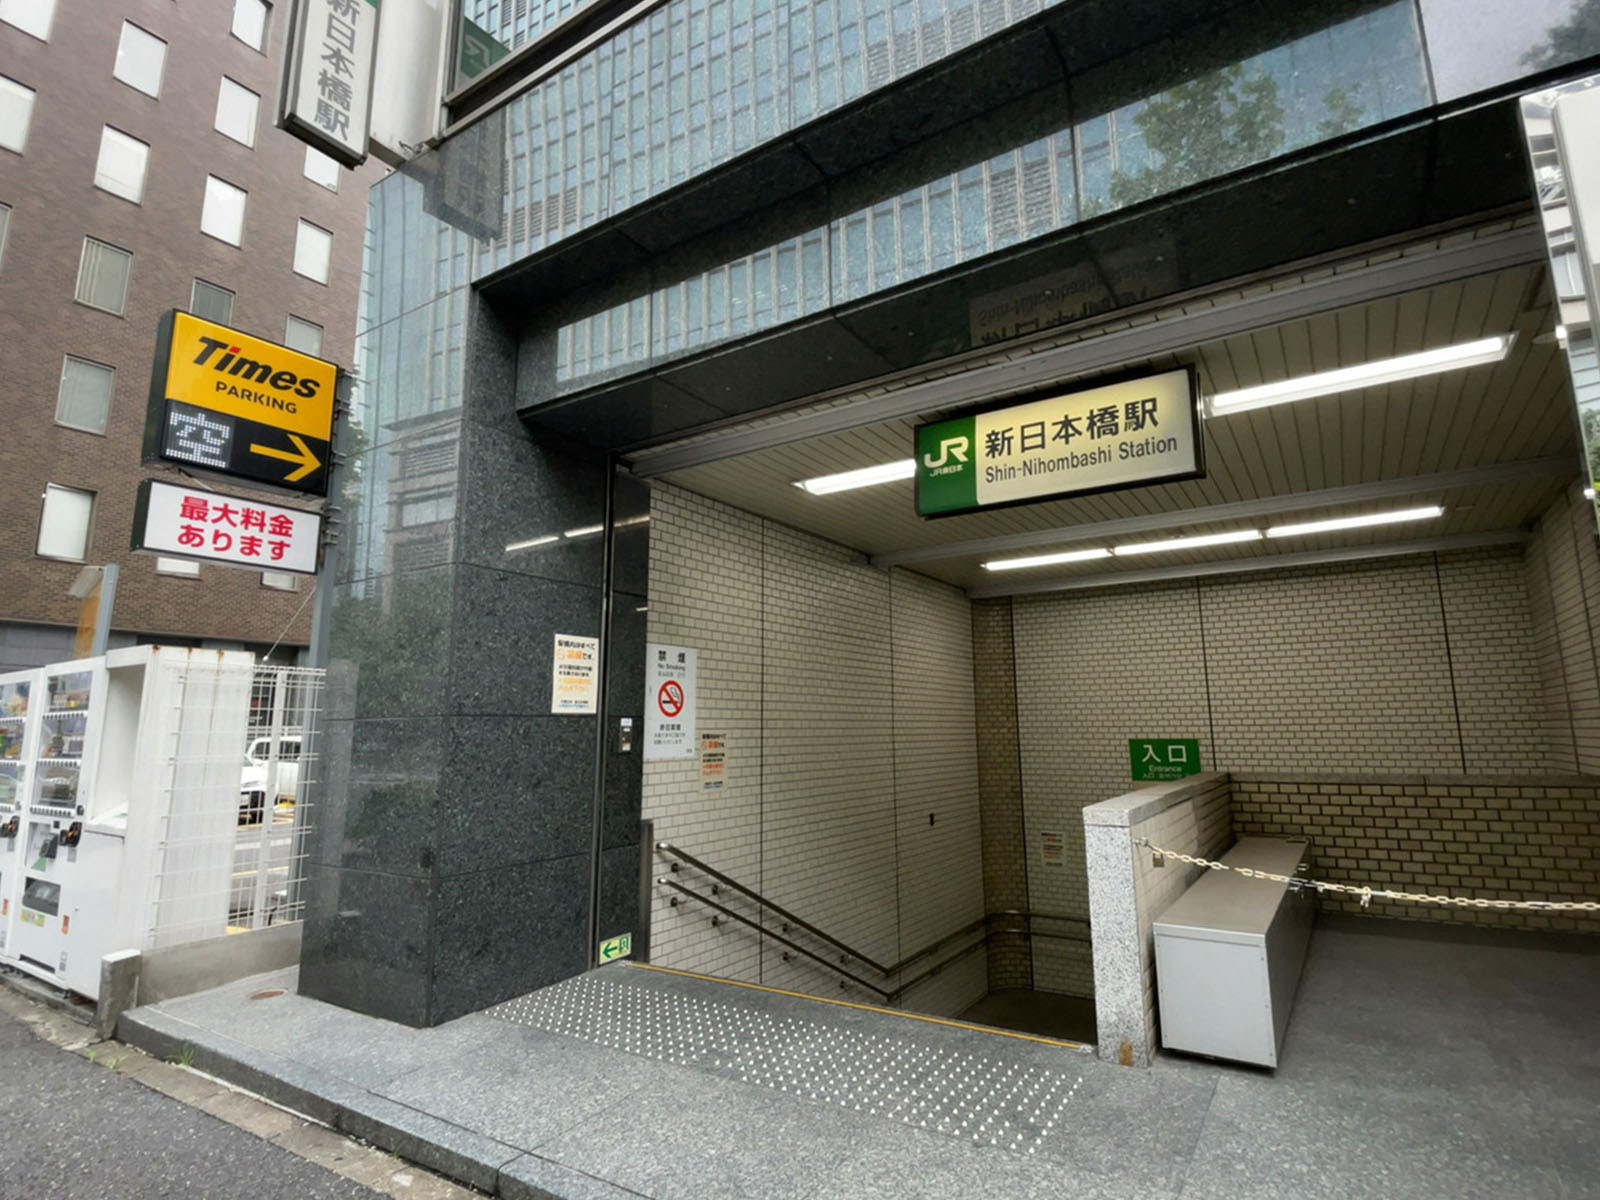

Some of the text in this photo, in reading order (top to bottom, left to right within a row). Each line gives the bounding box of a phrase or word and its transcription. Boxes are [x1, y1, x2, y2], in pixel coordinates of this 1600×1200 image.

[193, 336, 321, 398] Times
[216, 381, 298, 414] PARKING
[165, 411, 230, 468] 空
[985, 397, 1159, 460] 新日本橋駅
[924, 436, 969, 468] JR
[985, 437, 1178, 483] Shin-Nihombashi Station
[179, 495, 294, 538] 最大料金
[177, 523, 292, 561] あります
[1142, 744, 1188, 763] 入口
[1148, 764, 1183, 773] Entrance
